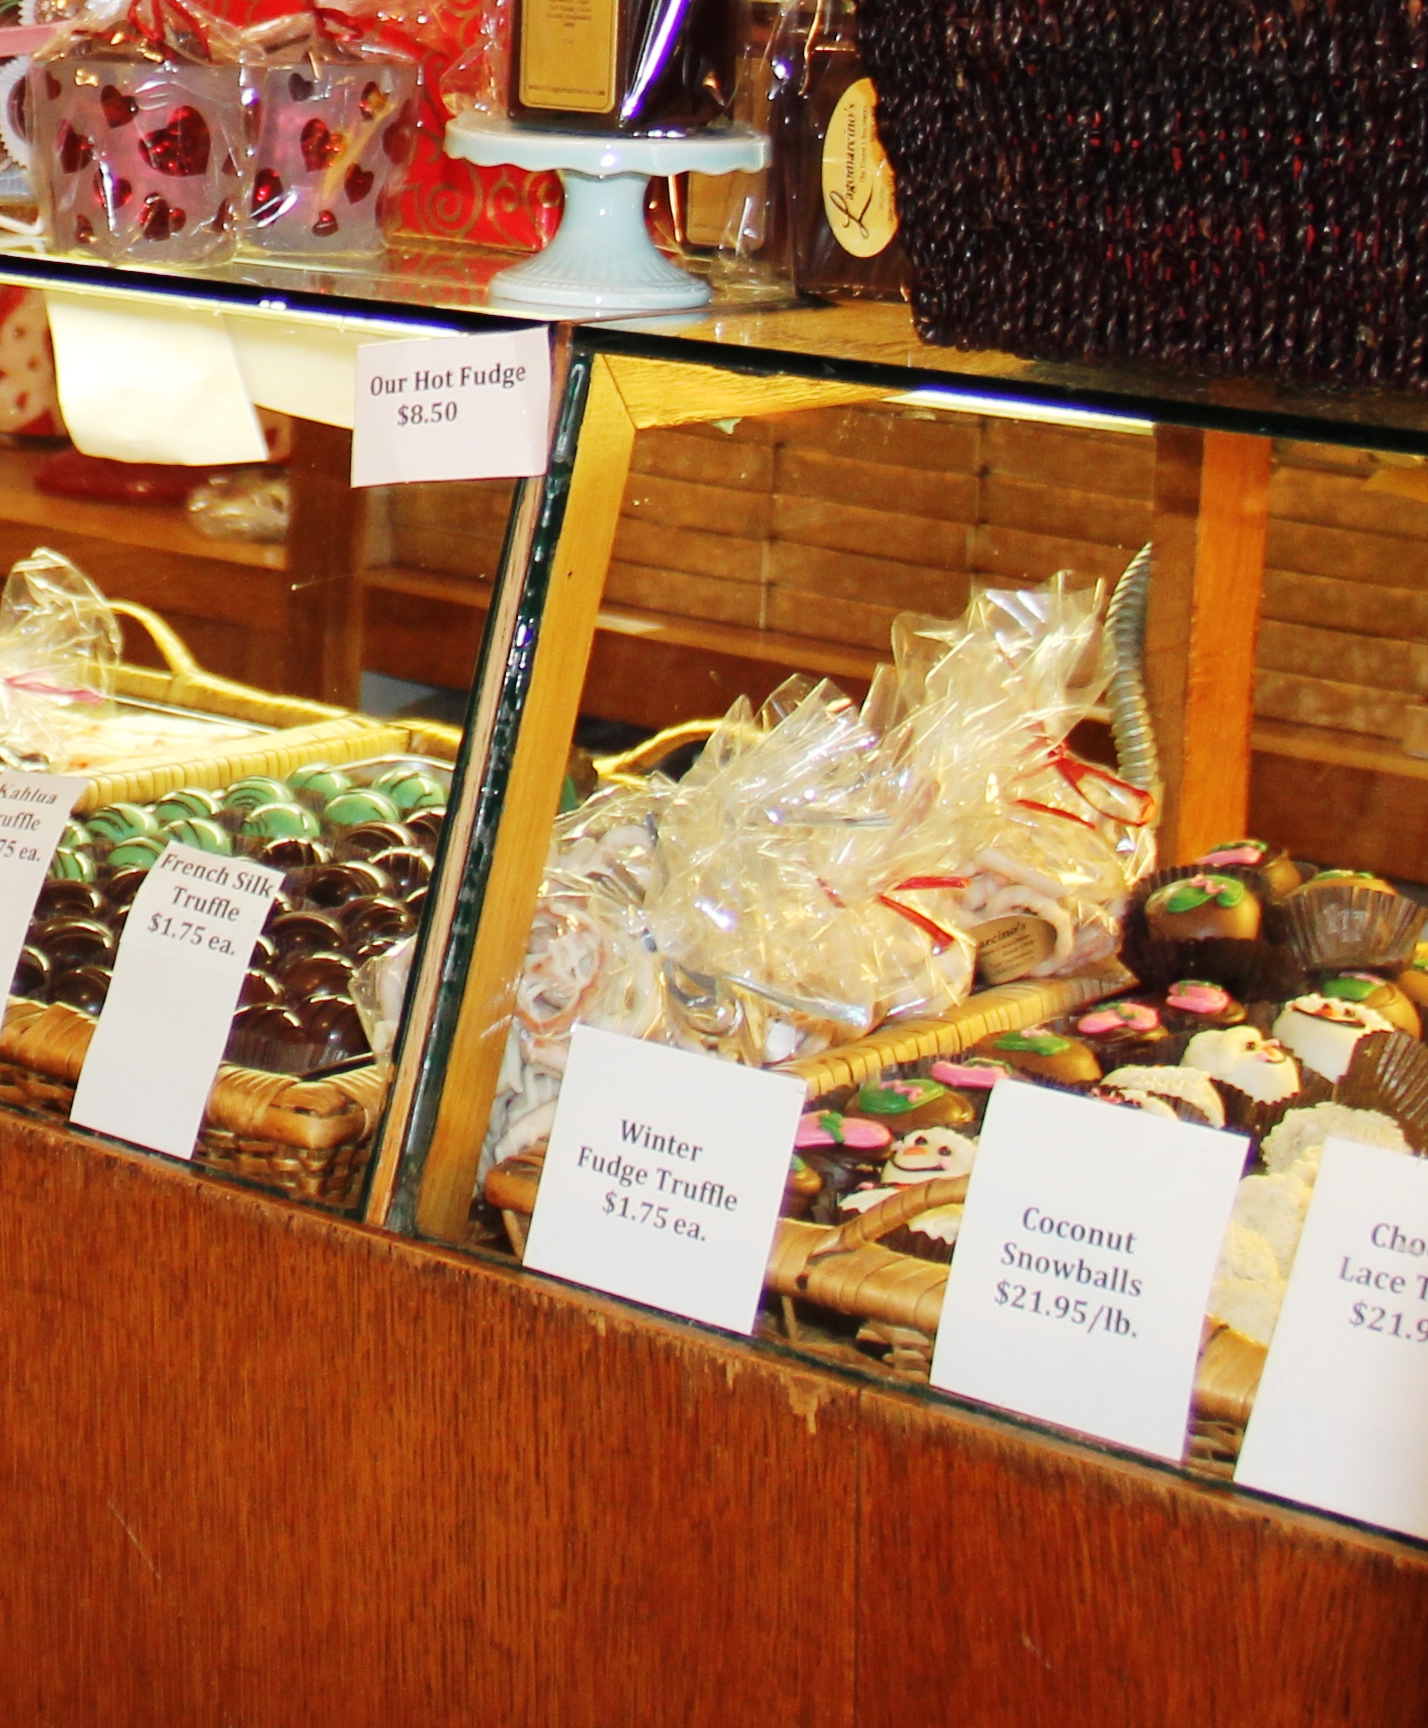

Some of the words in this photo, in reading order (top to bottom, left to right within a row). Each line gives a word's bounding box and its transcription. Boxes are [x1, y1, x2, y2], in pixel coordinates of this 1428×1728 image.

[828, 102, 874, 239] Lagomarcino's
[370, 375, 408, 397] Our
[415, 369, 455, 393] Hot
[460, 364, 527, 391] Fudge
[396, 401, 458, 428] $8.50
[18, 845, 41, 863] ea.
[159, 853, 229, 885] French
[232, 871, 276, 899] Silk
[171, 886, 240, 923] Truffle
[147, 912, 204, 946] $1.75
[207, 936, 236, 957] ea.
[619, 1118, 704, 1162] Winter
[576, 1145, 648, 1188] Fudge
[656, 1167, 738, 1212] Truffle
[601, 1190, 667, 1231] $1.75
[674, 1214, 706, 1243] ea.
[1021, 1205, 1137, 1256] Coconut
[1370, 1222, 1428, 1257] Cho
[1000, 1241, 1143, 1297] Snowballs
[1339, 1255, 1406, 1294] Lace
[993, 1278, 1138, 1339] $21.95/lb.
